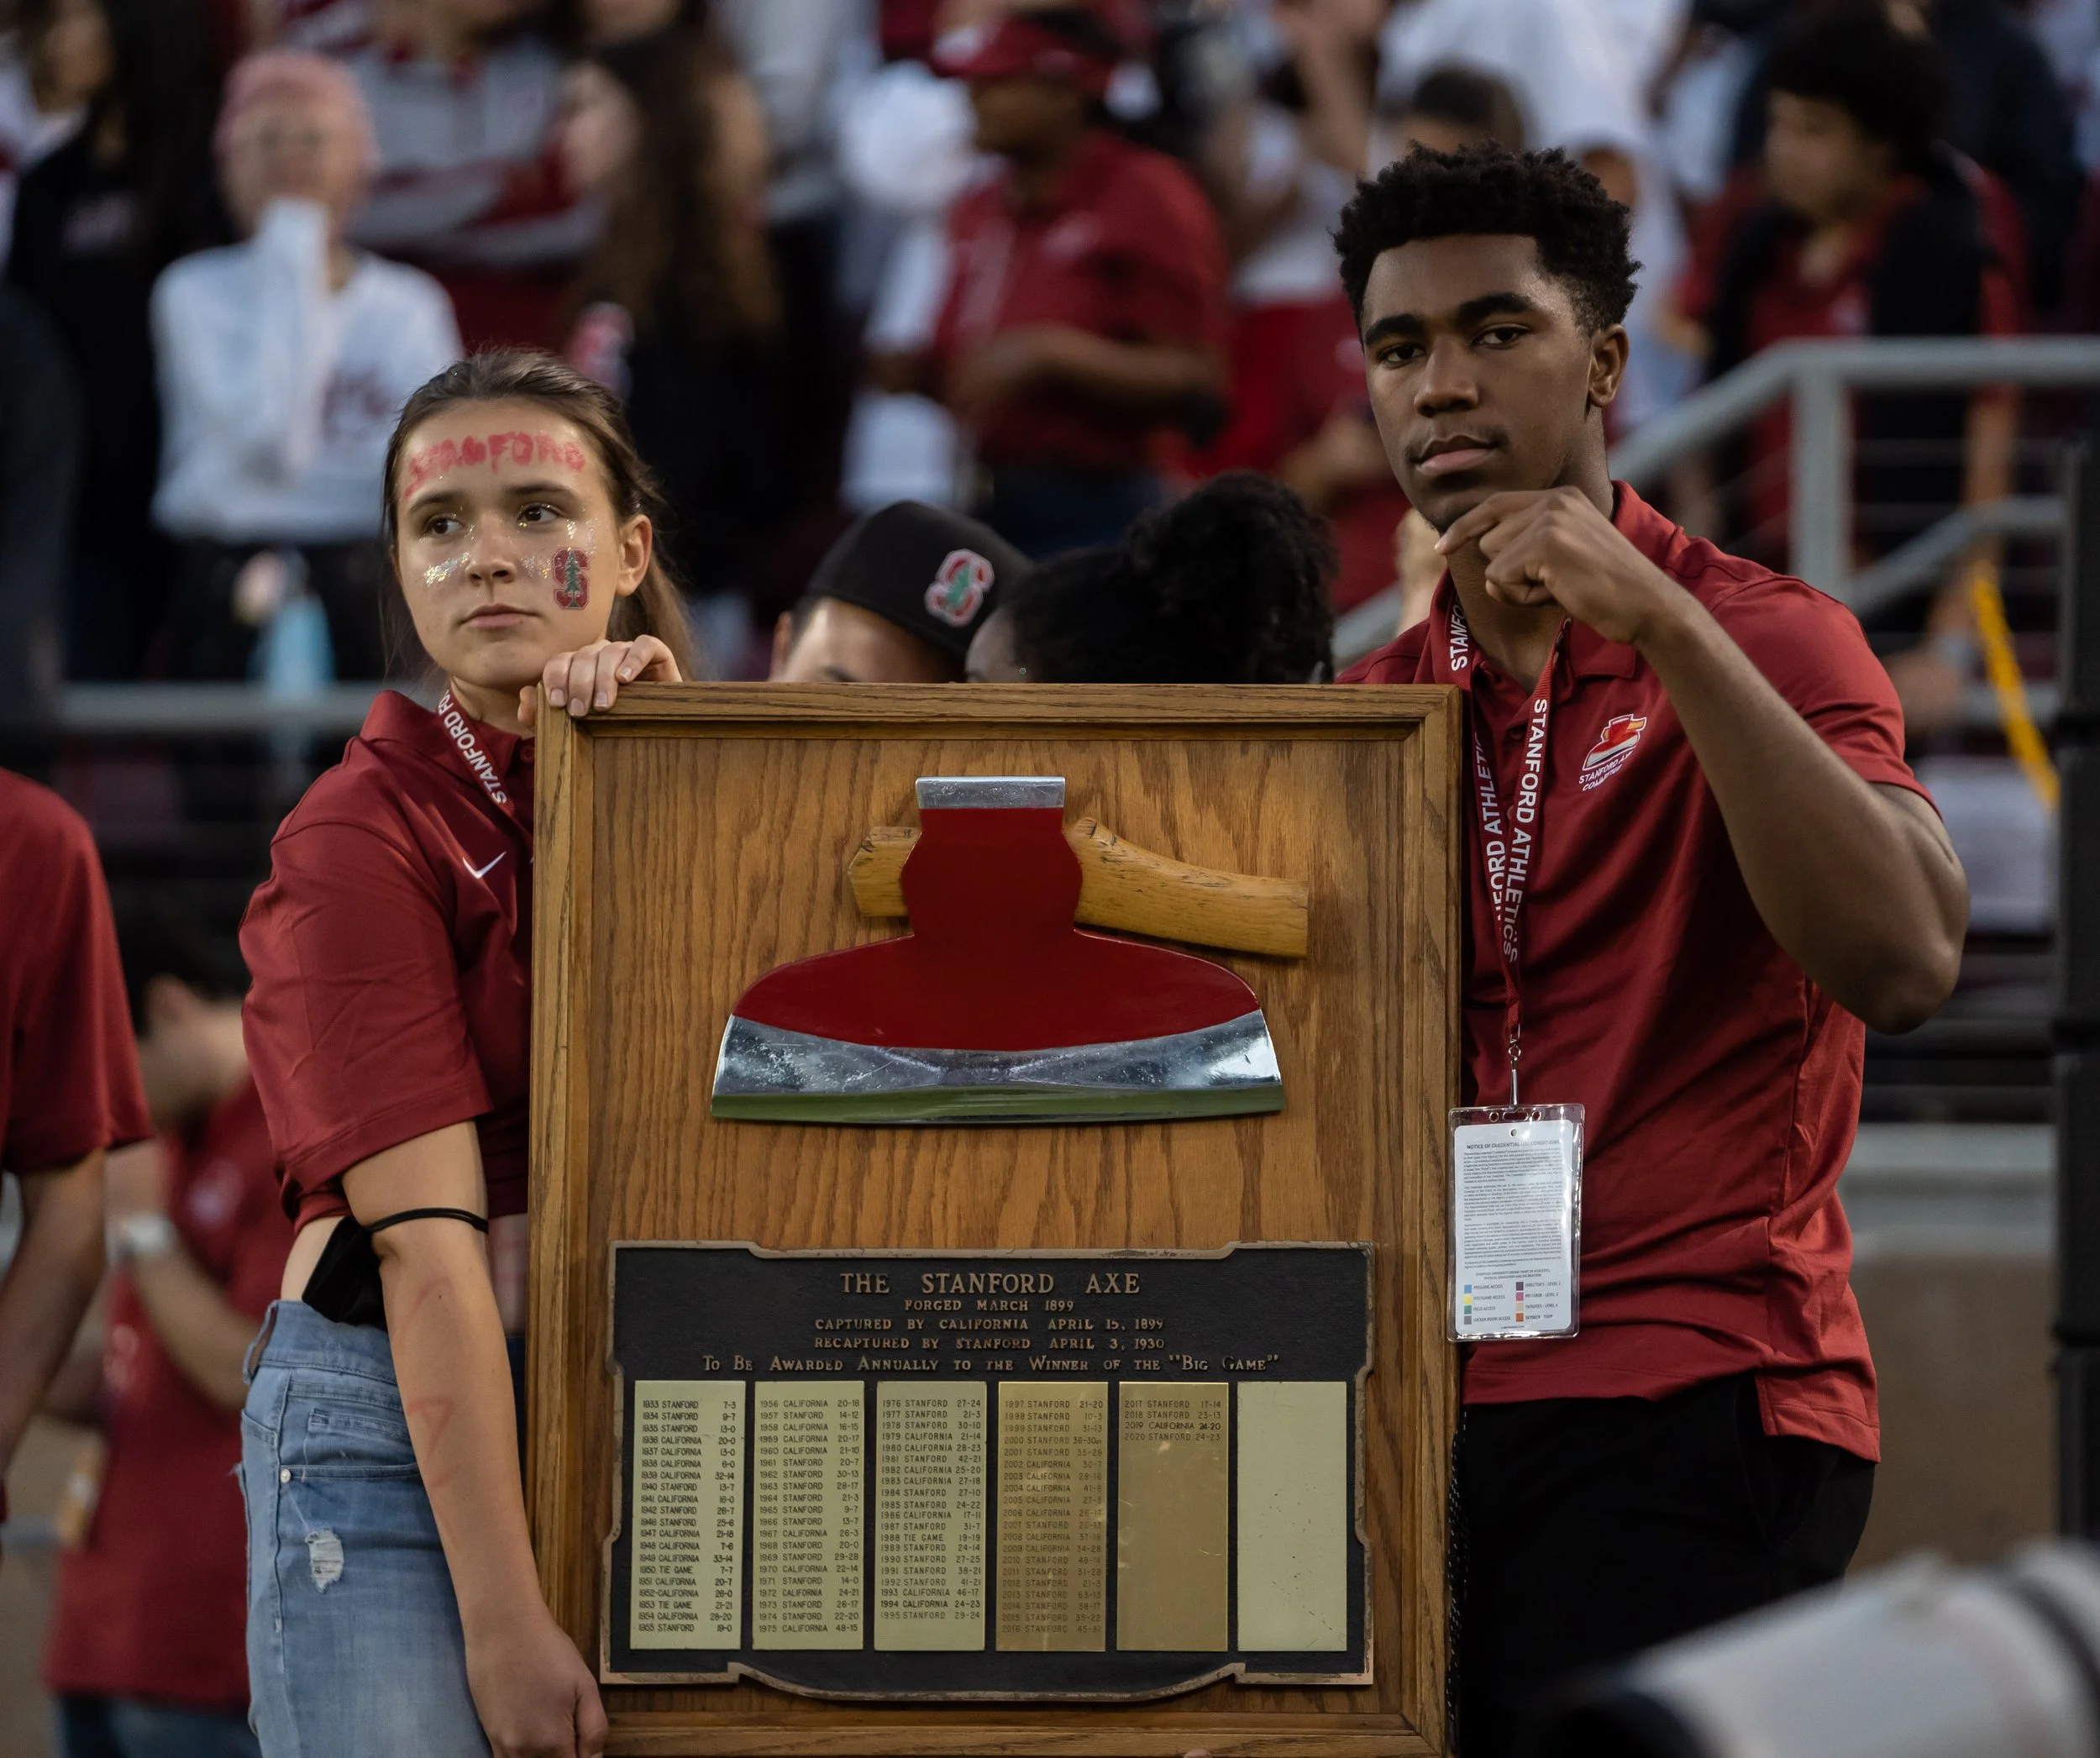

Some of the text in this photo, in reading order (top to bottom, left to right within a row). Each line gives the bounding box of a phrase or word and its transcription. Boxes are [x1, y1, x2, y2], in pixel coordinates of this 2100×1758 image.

[444, 711, 507, 804] STANFORD
[1579, 759, 1619, 784] STANFORD
[1502, 699, 1547, 956] STANFORD ATHLETICS
[840, 1273, 1140, 1294] THE STANFORD AXE
[905, 1299, 1074, 1311] FORGED MARCH 1899
[815, 1319, 1164, 1331] CAPTURED BY CALIFORNIA APRIL 15, 1899
[815, 1337, 1164, 1351] RECAPTURED BY STANFORD APRIL 3, 1930
[643, 1400, 659, 1409] 1933
[662, 1400, 699, 1409] STANFORD
[783, 1399, 828, 1408] CALIFORNIA
[883, 1399, 981, 1408] 1976 STANFORD 27-24
[1124, 1400, 1221, 1410] 2017 STANFORD 17-14
[760, 1412, 779, 1420] 1957
[783, 1411, 823, 1420] STANFORD
[905, 1410, 948, 1419] STANFORD
[963, 1410, 981, 1419] 21-3
[1124, 1410, 1221, 1421] 2018 STANFORD 23-13
[1125, 1421, 1144, 1430] 2019
[1148, 1422, 1194, 1431] CALIFORNIA
[643, 1435, 659, 1444] 1936
[883, 1432, 981, 1441] 1979 CALIFORNIA 21-14
[1124, 1432, 1221, 1441] 2020 STANFORD 24-23
[783, 1446, 827, 1455] CALIFORNIA
[883, 1444, 981, 1452] 1980 CALIFORNIA 28-23
[783, 1470, 823, 1478] STANFORD
[837, 1470, 859, 1478] 30-13
[882, 1466, 981, 1474] 1982 CALIFORNIA 25-20
[642, 1471, 658, 1479] 1939
[715, 1472, 734, 1480] 32-14
[882, 1488, 981, 1497] 1984 STANFORD 27-10
[881, 1511, 900, 1519] 1986
[963, 1511, 981, 1519] 17-11
[881, 1522, 981, 1532] 1987 STANFORD 31-7
[759, 1529, 859, 1538] 1967 CALIFORNIA 26-3
[904, 1534, 916, 1542] TIE
[921, 1534, 943, 1542] GAME
[959, 1534, 981, 1542] 19-19
[904, 1555, 946, 1563] STANFORD
[956, 1555, 980, 1563] 27-25
[782, 1565, 827, 1573] CALIFORNIA
[837, 1565, 858, 1573] 22-14
[881, 1566, 981, 1575] 1991 STANFORD 38-21
[955, 1600, 980, 1608] 24-23
[835, 1612, 858, 1620] 22-20
[658, 1624, 695, 1632] STANFORD
